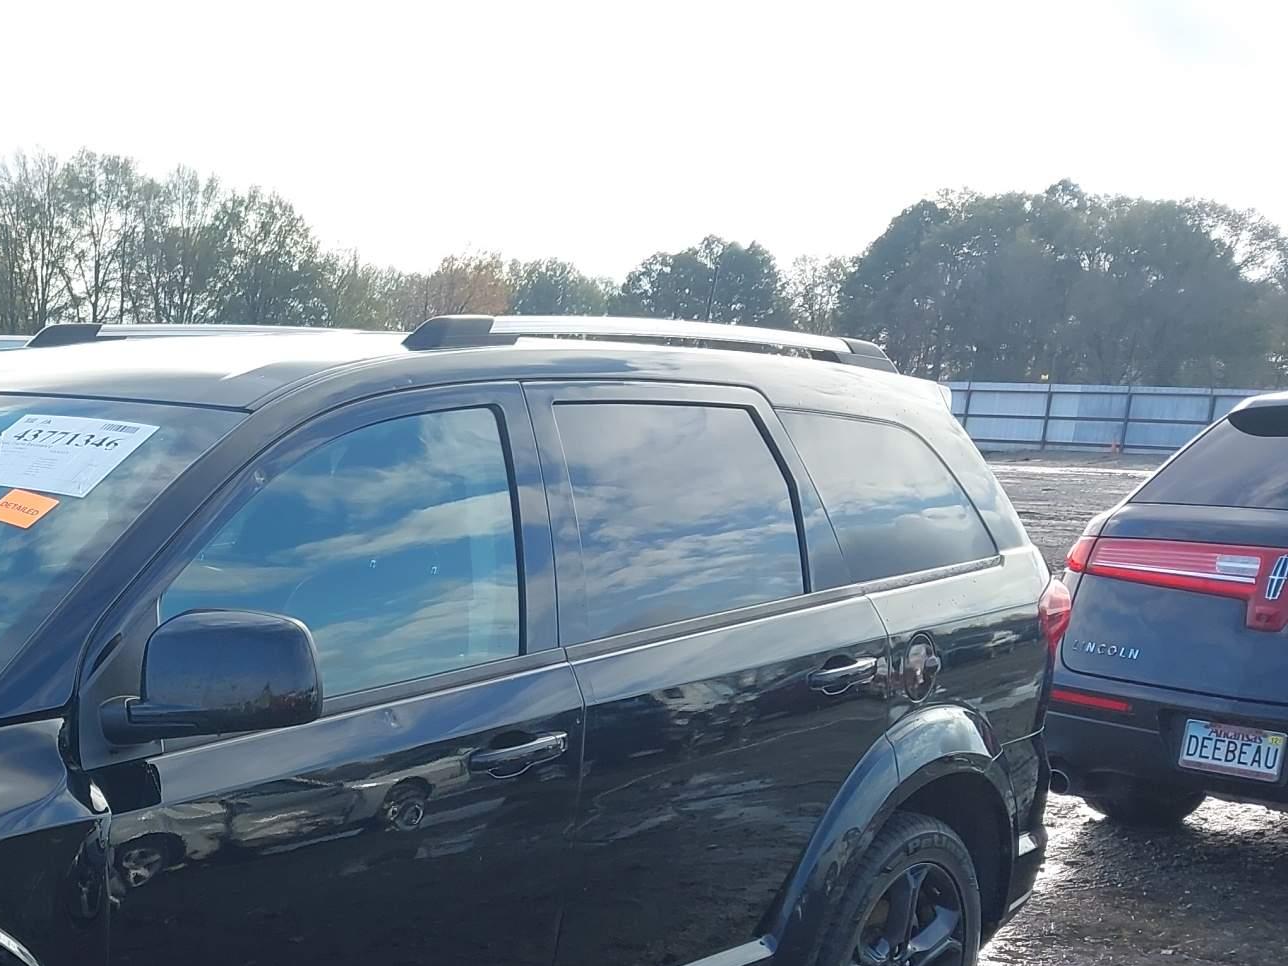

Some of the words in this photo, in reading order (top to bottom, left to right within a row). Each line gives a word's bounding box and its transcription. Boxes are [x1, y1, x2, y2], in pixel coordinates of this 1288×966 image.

[13, 428, 124, 451] 43771346
[0, 501, 40, 516] DETAILED
[1185, 734, 1279, 770] DEEBEAU
